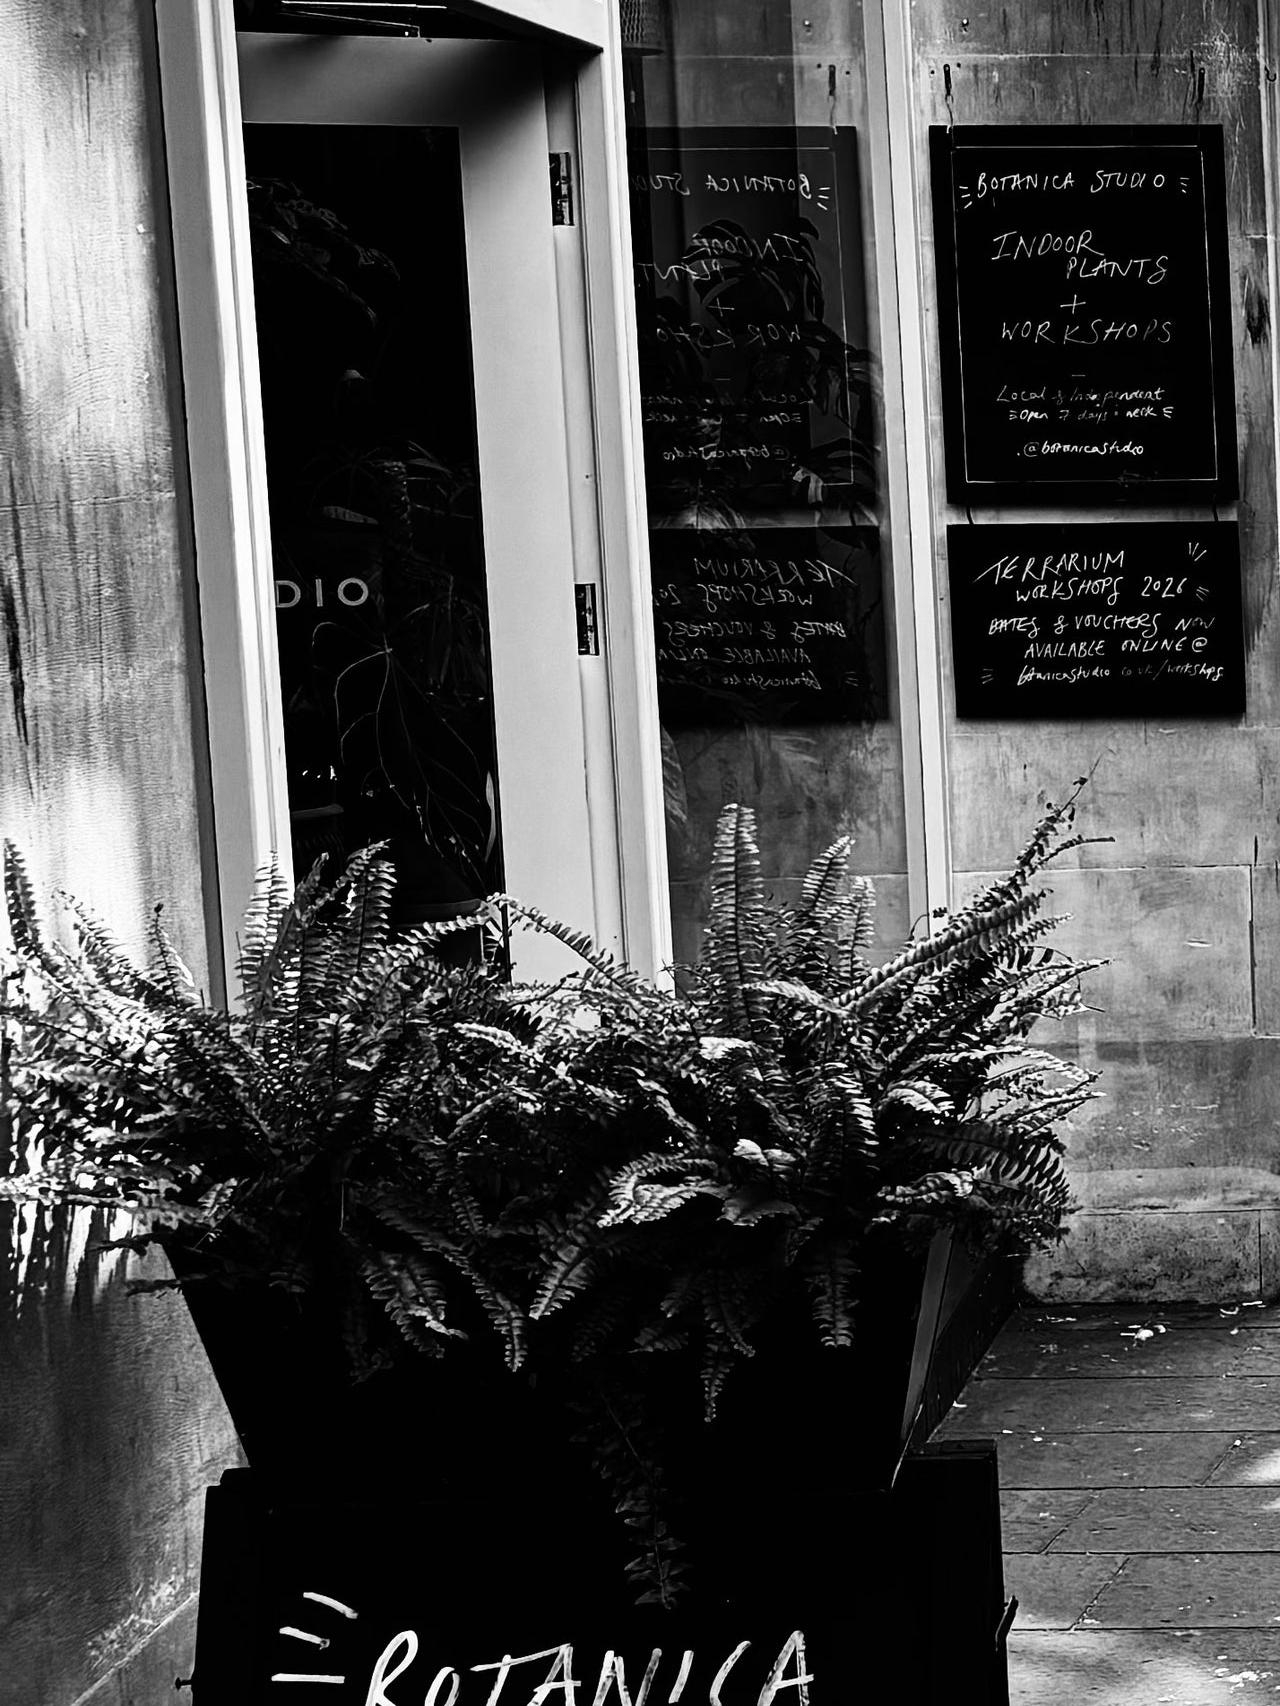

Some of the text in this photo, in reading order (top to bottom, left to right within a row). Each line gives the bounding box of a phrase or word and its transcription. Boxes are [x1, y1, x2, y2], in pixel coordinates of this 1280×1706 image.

[977, 169, 1166, 200] BOTANICA STUDIO
[991, 230, 1105, 261] INDOOR
[1065, 255, 1169, 285] PLANTS
[1000, 318, 1173, 346] WORKSHOPS
[973, 550, 1125, 586] TERRARIUM
[1015, 575, 1189, 607] WORKSHOPS 2026
[1074, 613, 1163, 640] VOUCHERS
[1023, 639, 1106, 660] AVAILABLE
[1121, 636, 1188, 653] ONLINE
